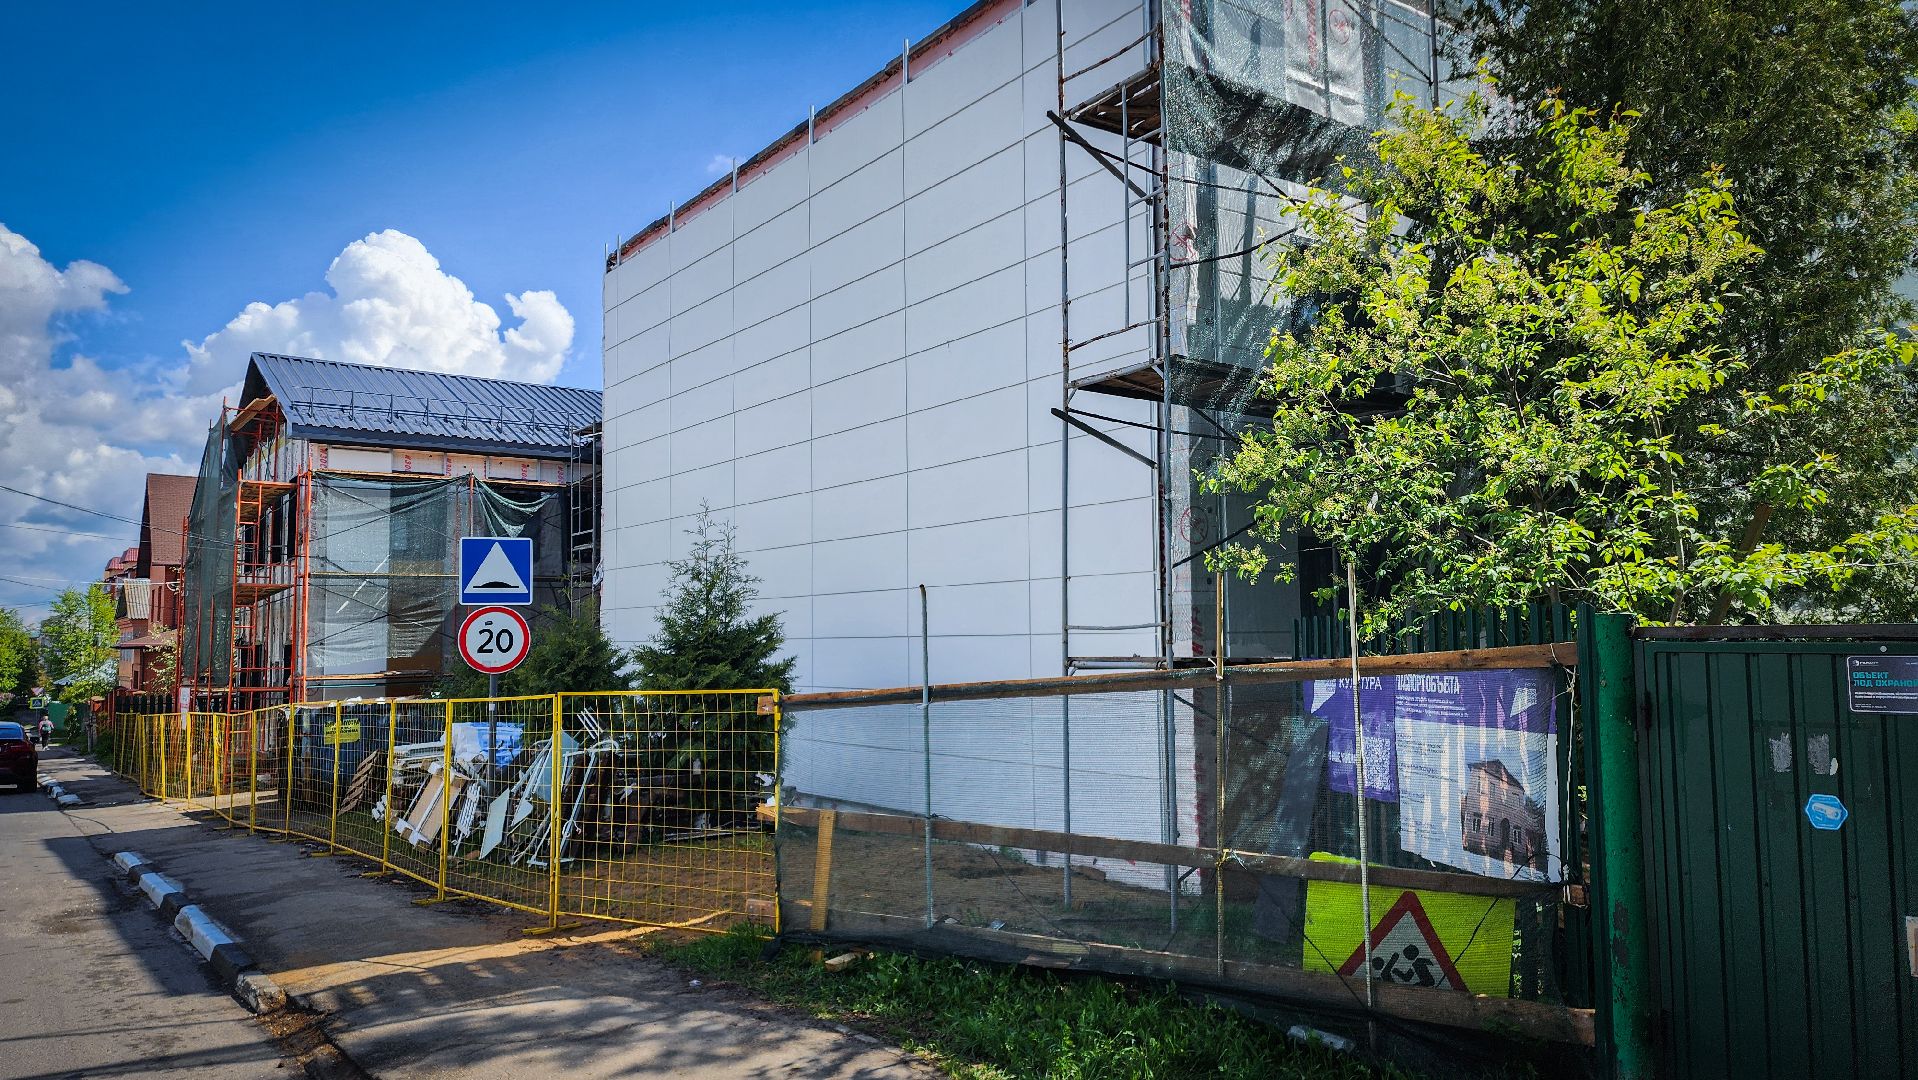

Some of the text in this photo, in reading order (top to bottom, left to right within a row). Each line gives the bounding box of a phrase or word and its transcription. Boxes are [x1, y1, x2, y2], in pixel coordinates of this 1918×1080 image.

[477, 628, 514, 654] 20
[1338, 676, 1383, 691] КУТУРА
[1425, 675, 1460, 695] ОБЪЕТА
[1853, 679, 1873, 687] ПОД
